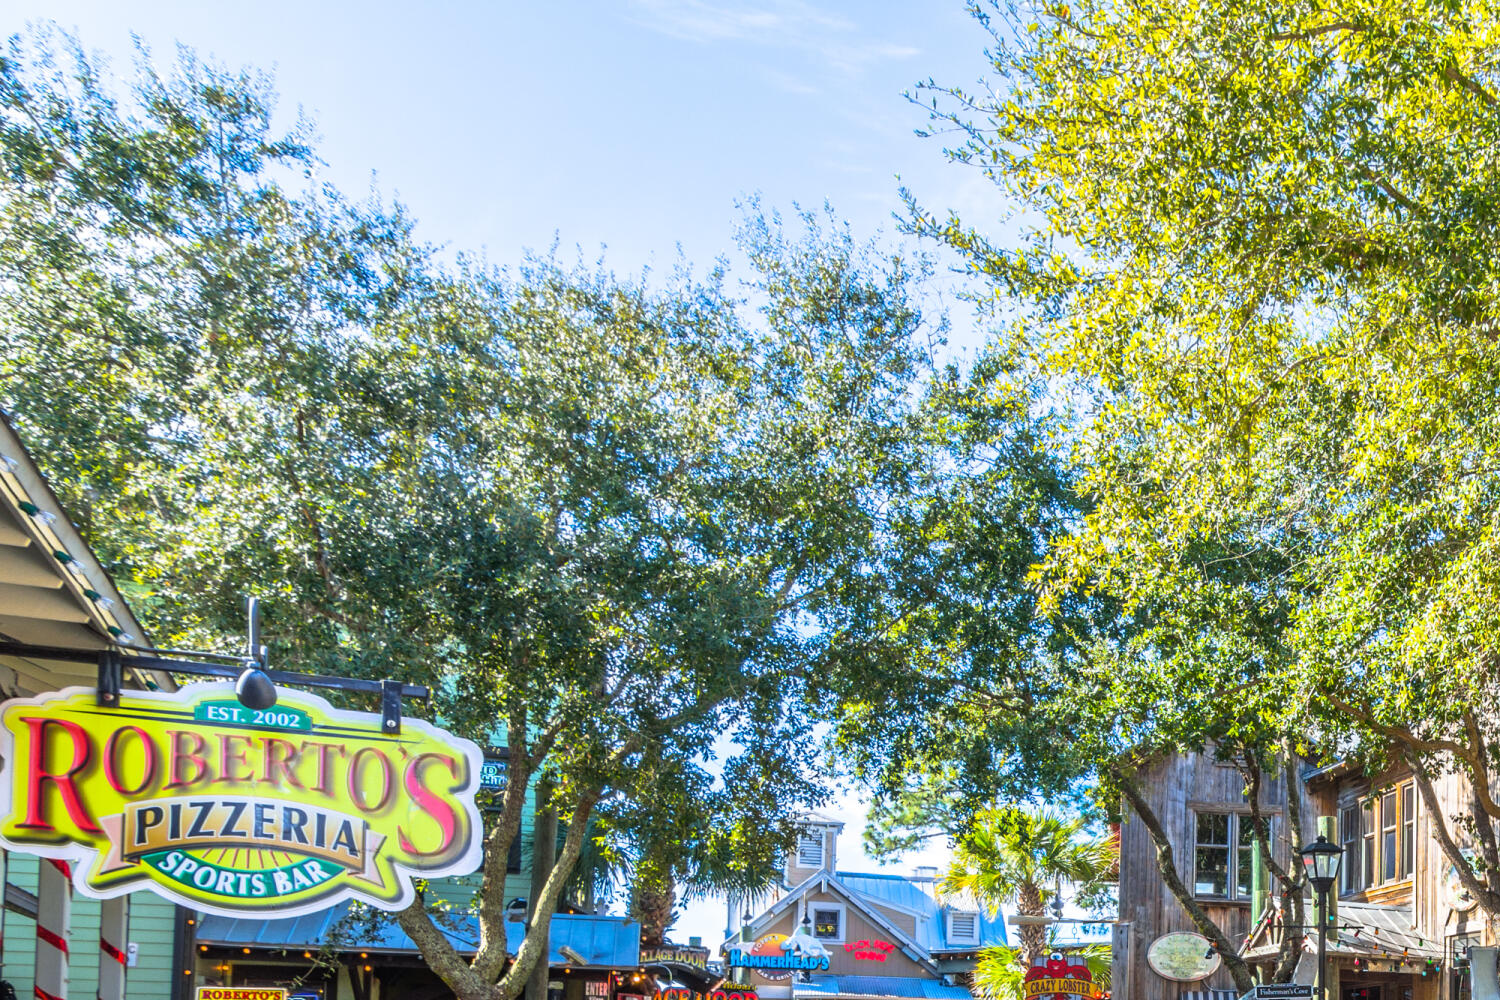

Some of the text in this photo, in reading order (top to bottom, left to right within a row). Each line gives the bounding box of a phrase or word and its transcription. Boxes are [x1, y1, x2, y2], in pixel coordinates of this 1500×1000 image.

[206, 705, 301, 728] EST. 2002
[16, 716, 458, 856] ROBERTO'S
[135, 801, 361, 859] PIZZERIA
[157, 849, 332, 895] SPORTS BAR
[730, 948, 829, 971] HAMMERHEAD'S
[757, 969, 768, 979] BAR
[202, 990, 281, 1000] ROBERTO'S
[585, 981, 608, 996] ENTER
[1030, 980, 1091, 994] CRAZY LOBSTER
[1259, 987, 1309, 996] Fisherman's Cove
